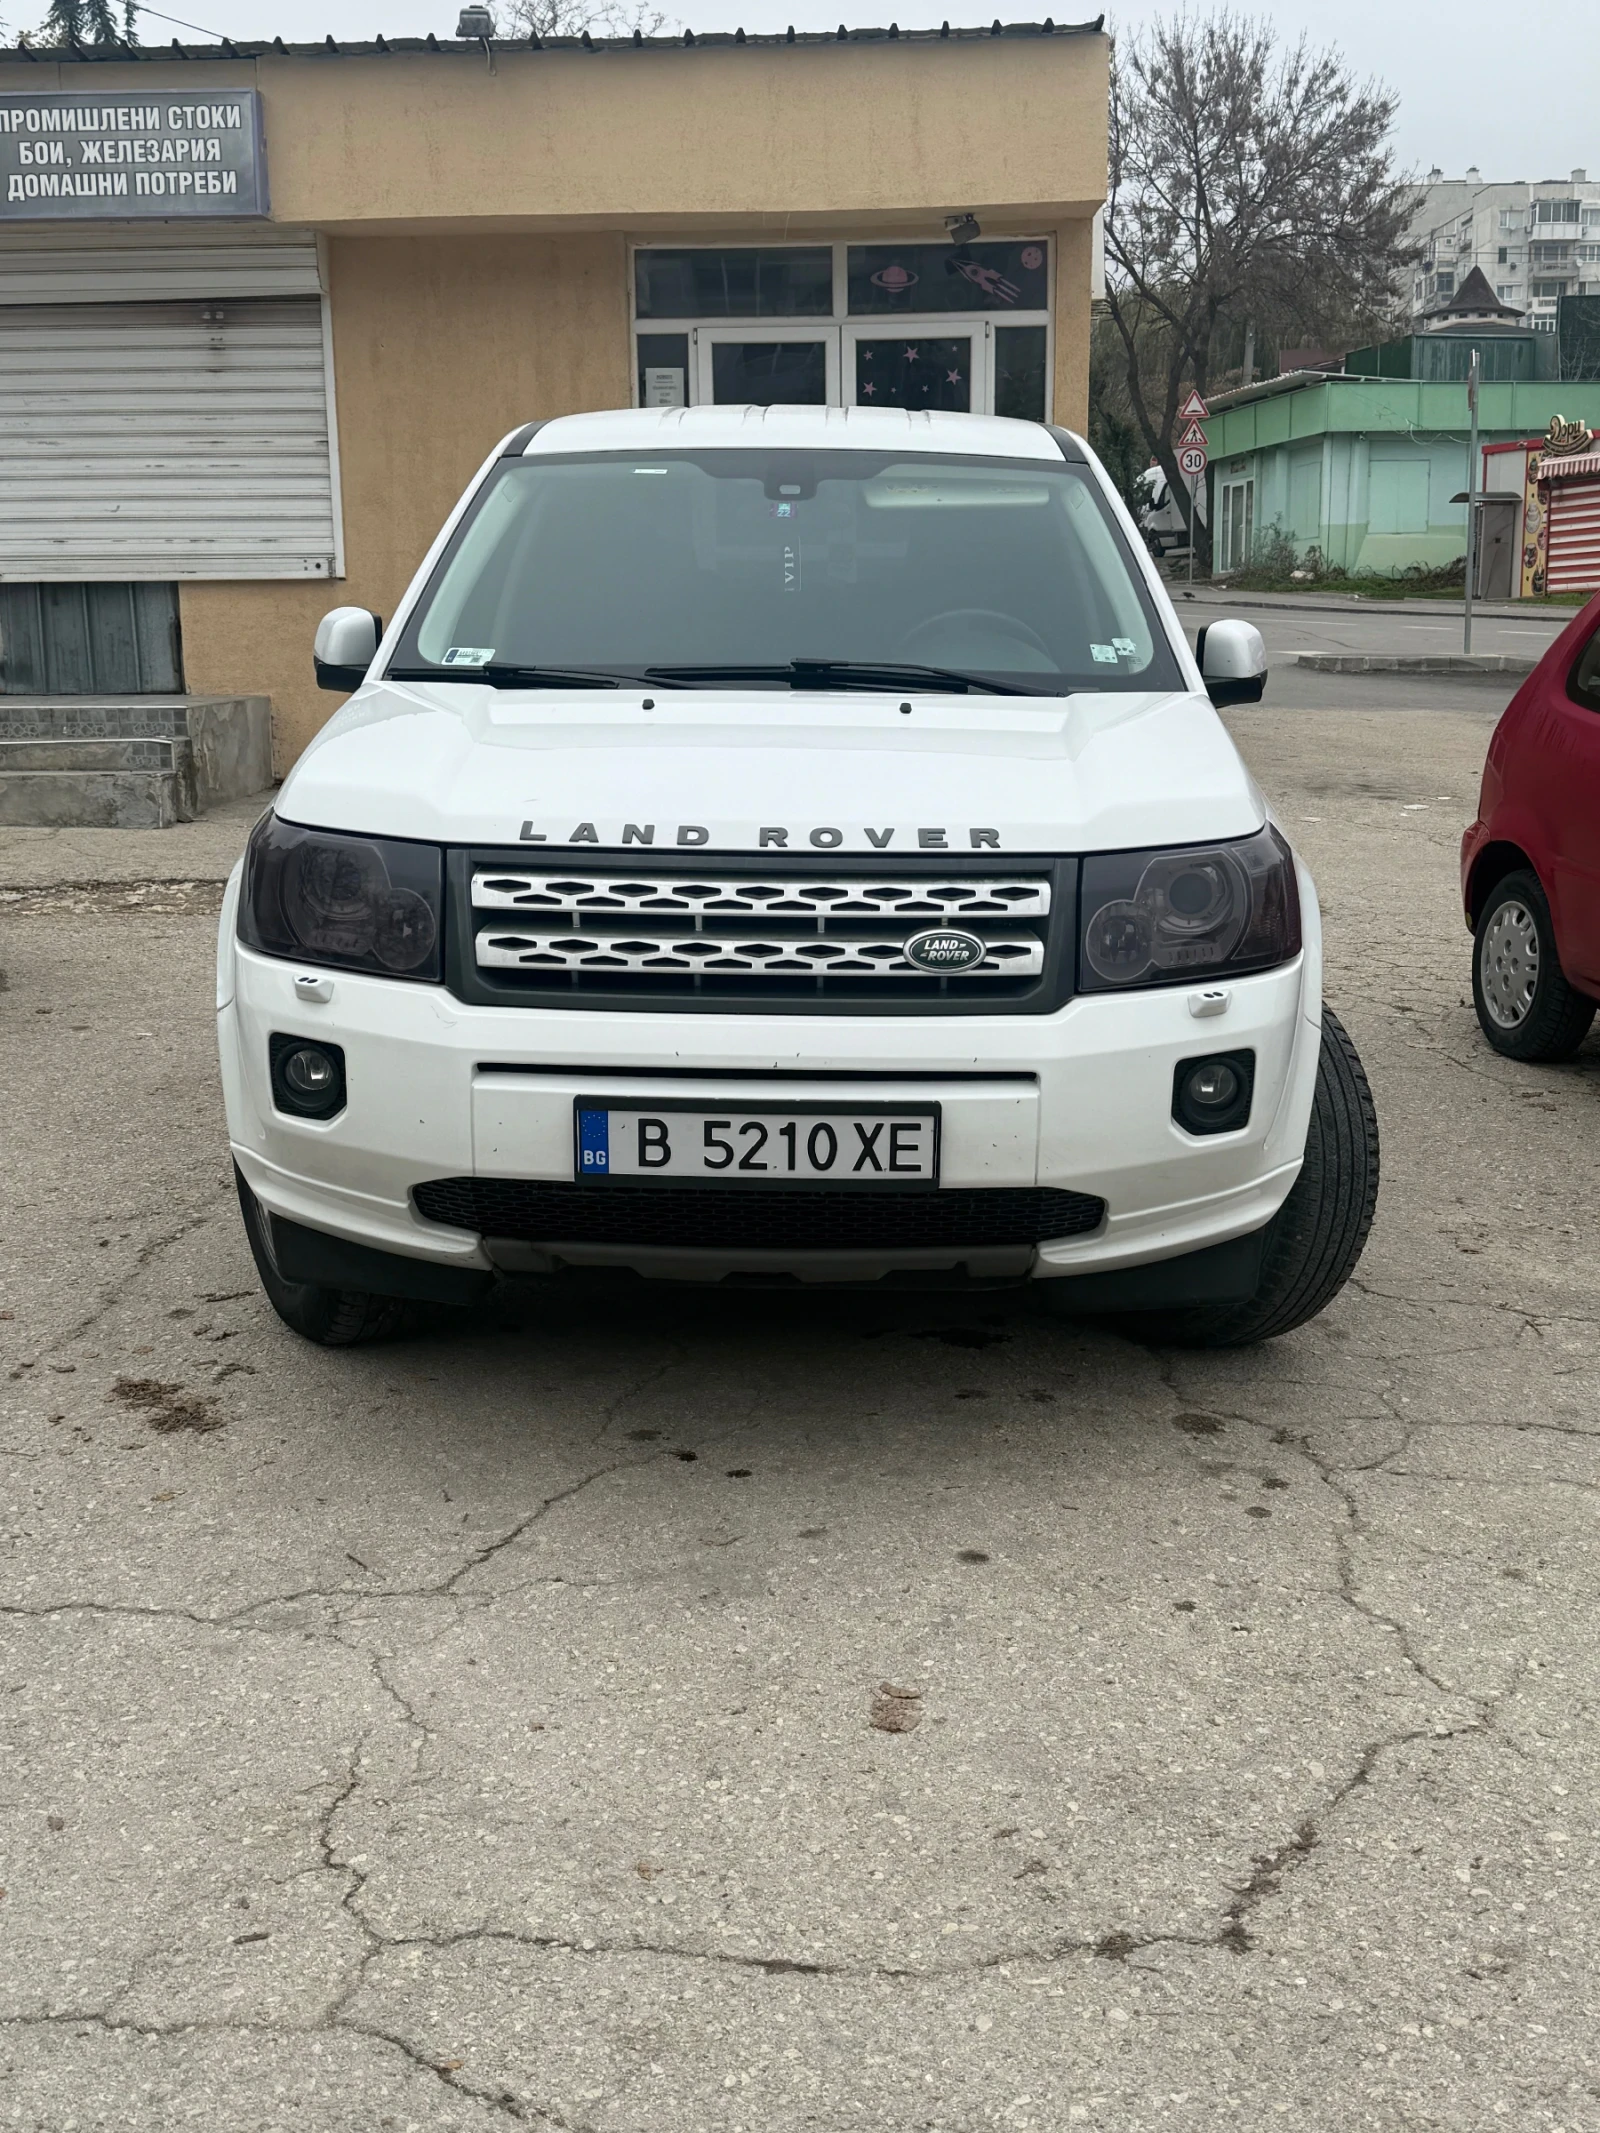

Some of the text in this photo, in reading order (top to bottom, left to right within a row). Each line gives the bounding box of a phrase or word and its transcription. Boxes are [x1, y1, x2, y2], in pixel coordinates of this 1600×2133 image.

[0, 105, 241, 133] ПРОМИШЛЕНИ СТОКИ
[19, 138, 221, 167] БОИ, ЖЕЛЕЗАРИЯ
[8, 170, 237, 201] ДОМАШНИ ПОТРЕБИ
[1185, 454, 1202, 468] 30
[784, 546, 795, 584] VIP
[519, 820, 1001, 850] LAND ROVER
[583, 1118, 922, 1172] BG B 5210 XE
